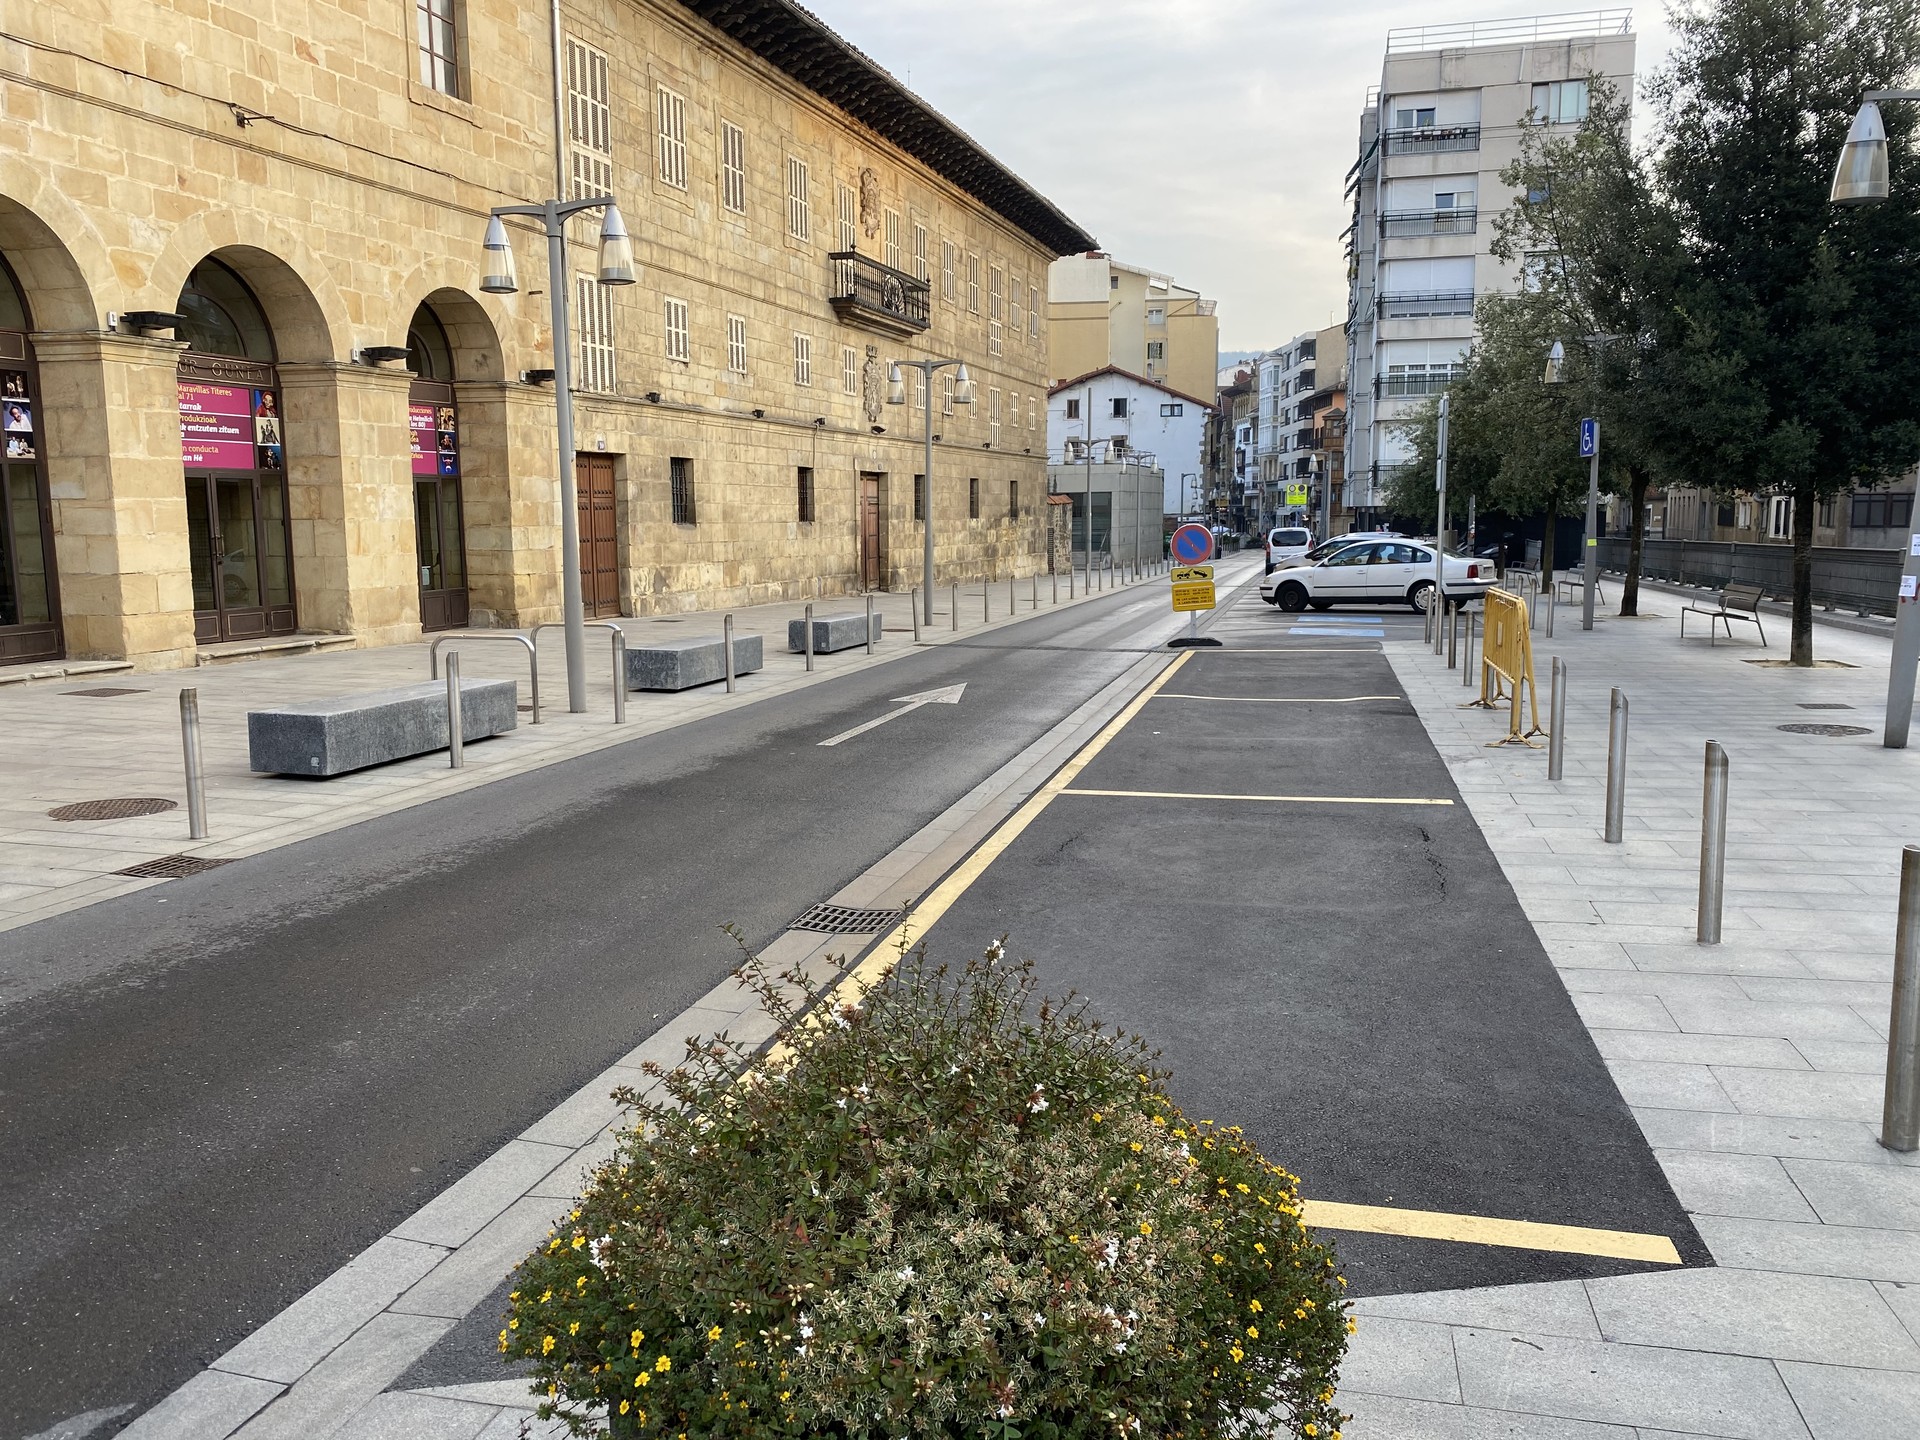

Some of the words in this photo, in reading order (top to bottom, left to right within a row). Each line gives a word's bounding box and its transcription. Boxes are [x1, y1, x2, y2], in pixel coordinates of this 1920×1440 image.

[212, 362, 264, 380] GUNEA
[186, 393, 194, 401] 71
[187, 425, 218, 433] entzuten
[218, 426, 240, 435] zituen
[188, 445, 219, 453] conducta
